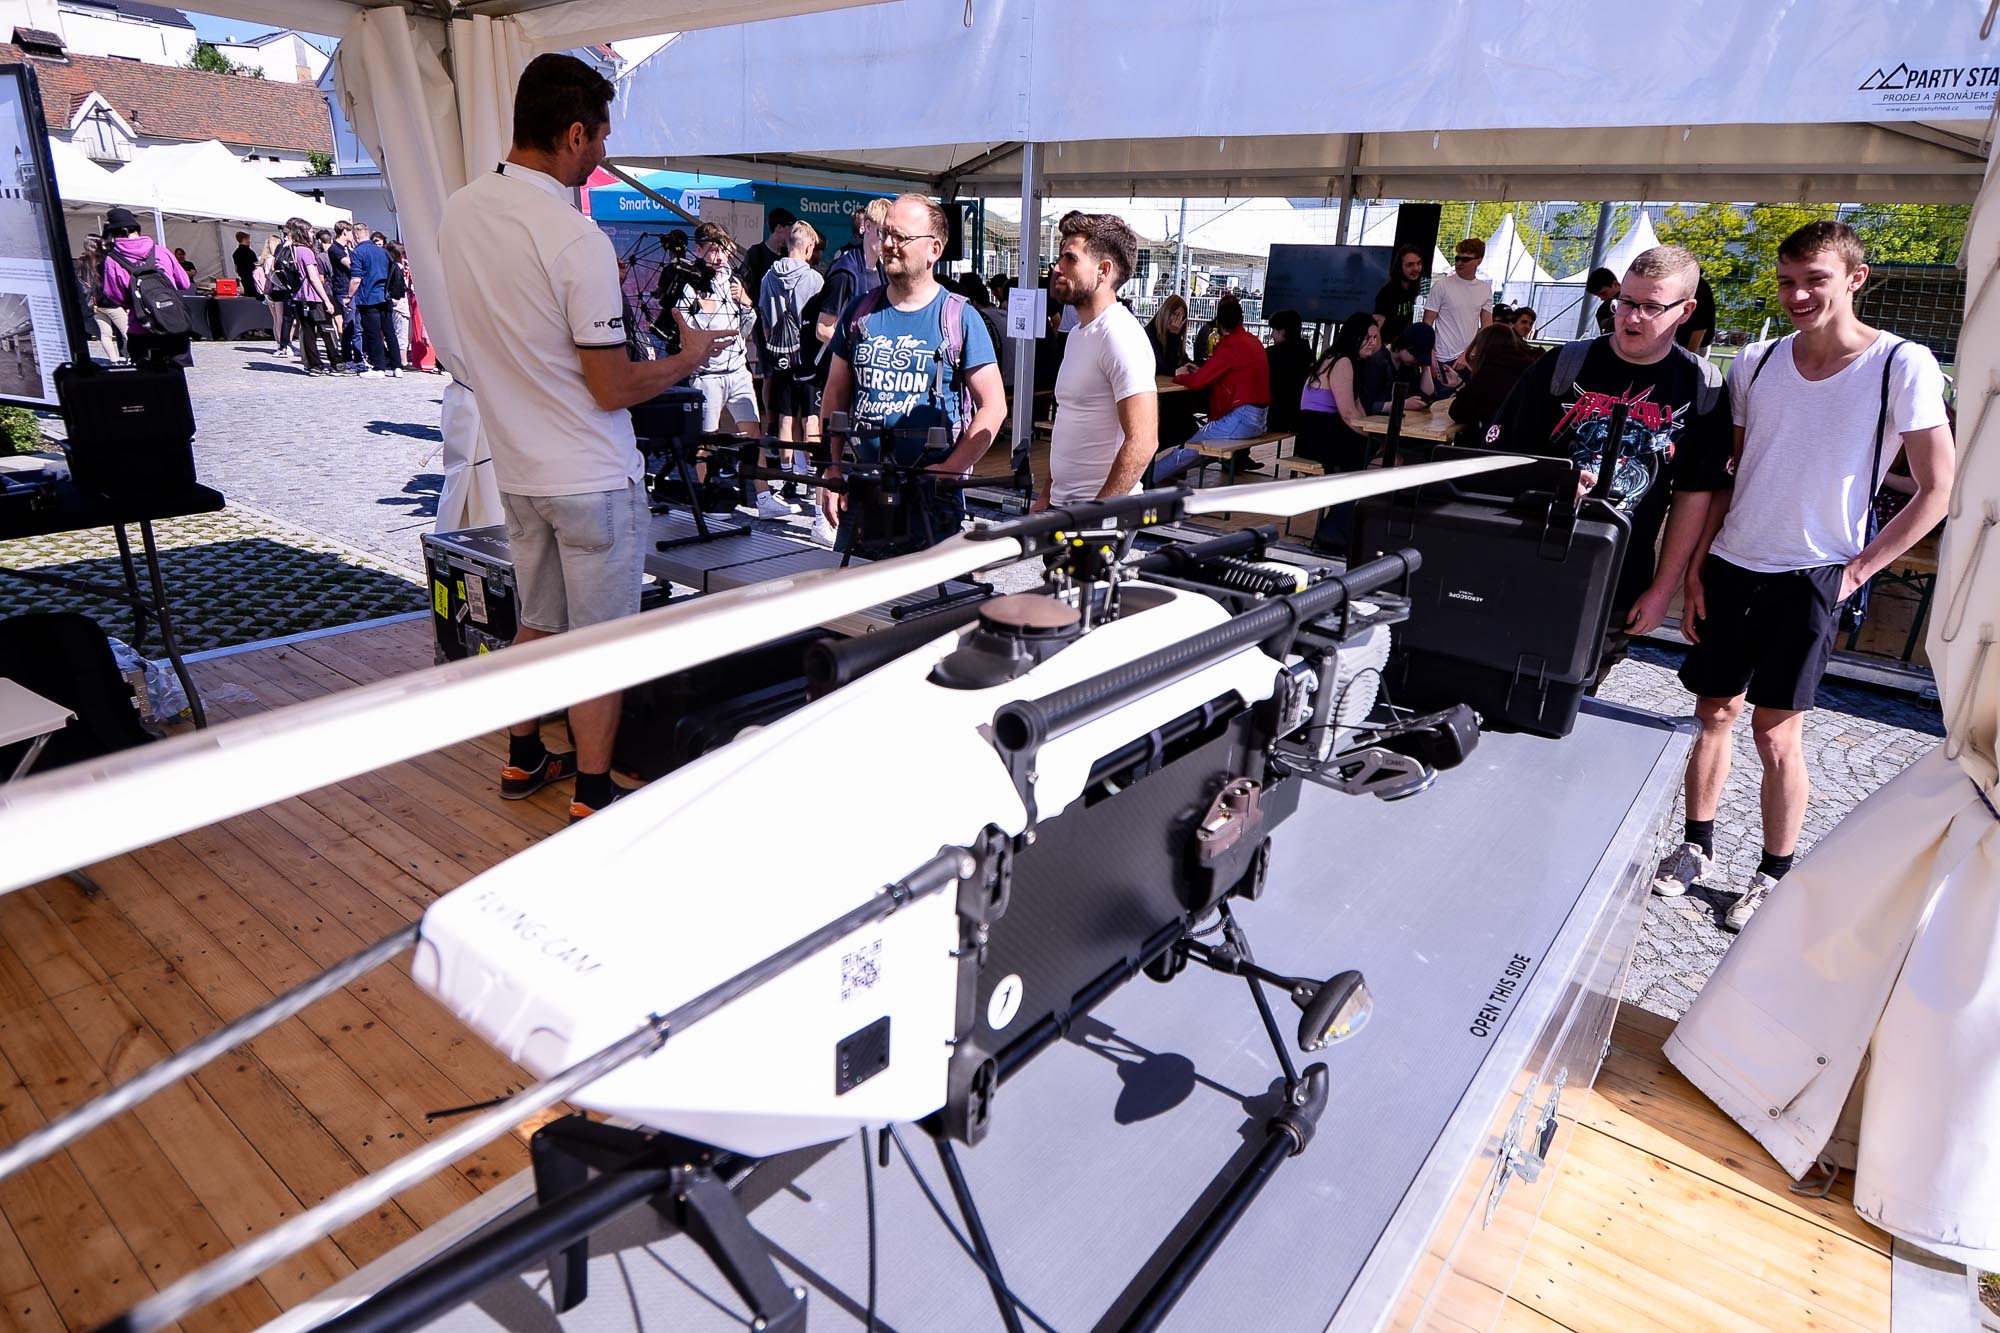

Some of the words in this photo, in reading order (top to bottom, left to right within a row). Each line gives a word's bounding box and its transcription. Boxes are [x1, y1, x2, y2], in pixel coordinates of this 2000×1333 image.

[1905, 68, 1965, 89] PARTY
[1966, 67, 2000, 88] STA
[1882, 93, 1921, 102] PRODEJ
[1933, 90, 1989, 101] PRONÁJEM
[619, 196, 651, 211] Smart
[800, 197, 840, 214] Smart
[593, 320, 606, 328] SIT
[868, 335, 893, 349] Be
[854, 344, 936, 372] BEST
[855, 367, 929, 393] VERSION
[856, 390, 921, 418] Yourself
[1448, 591, 1484, 602] AEROSCOPE
[1469, 1003, 1502, 1038] OPEN
[1488, 978, 1517, 1003] THIS
[1504, 953, 1532, 979] SIDE
